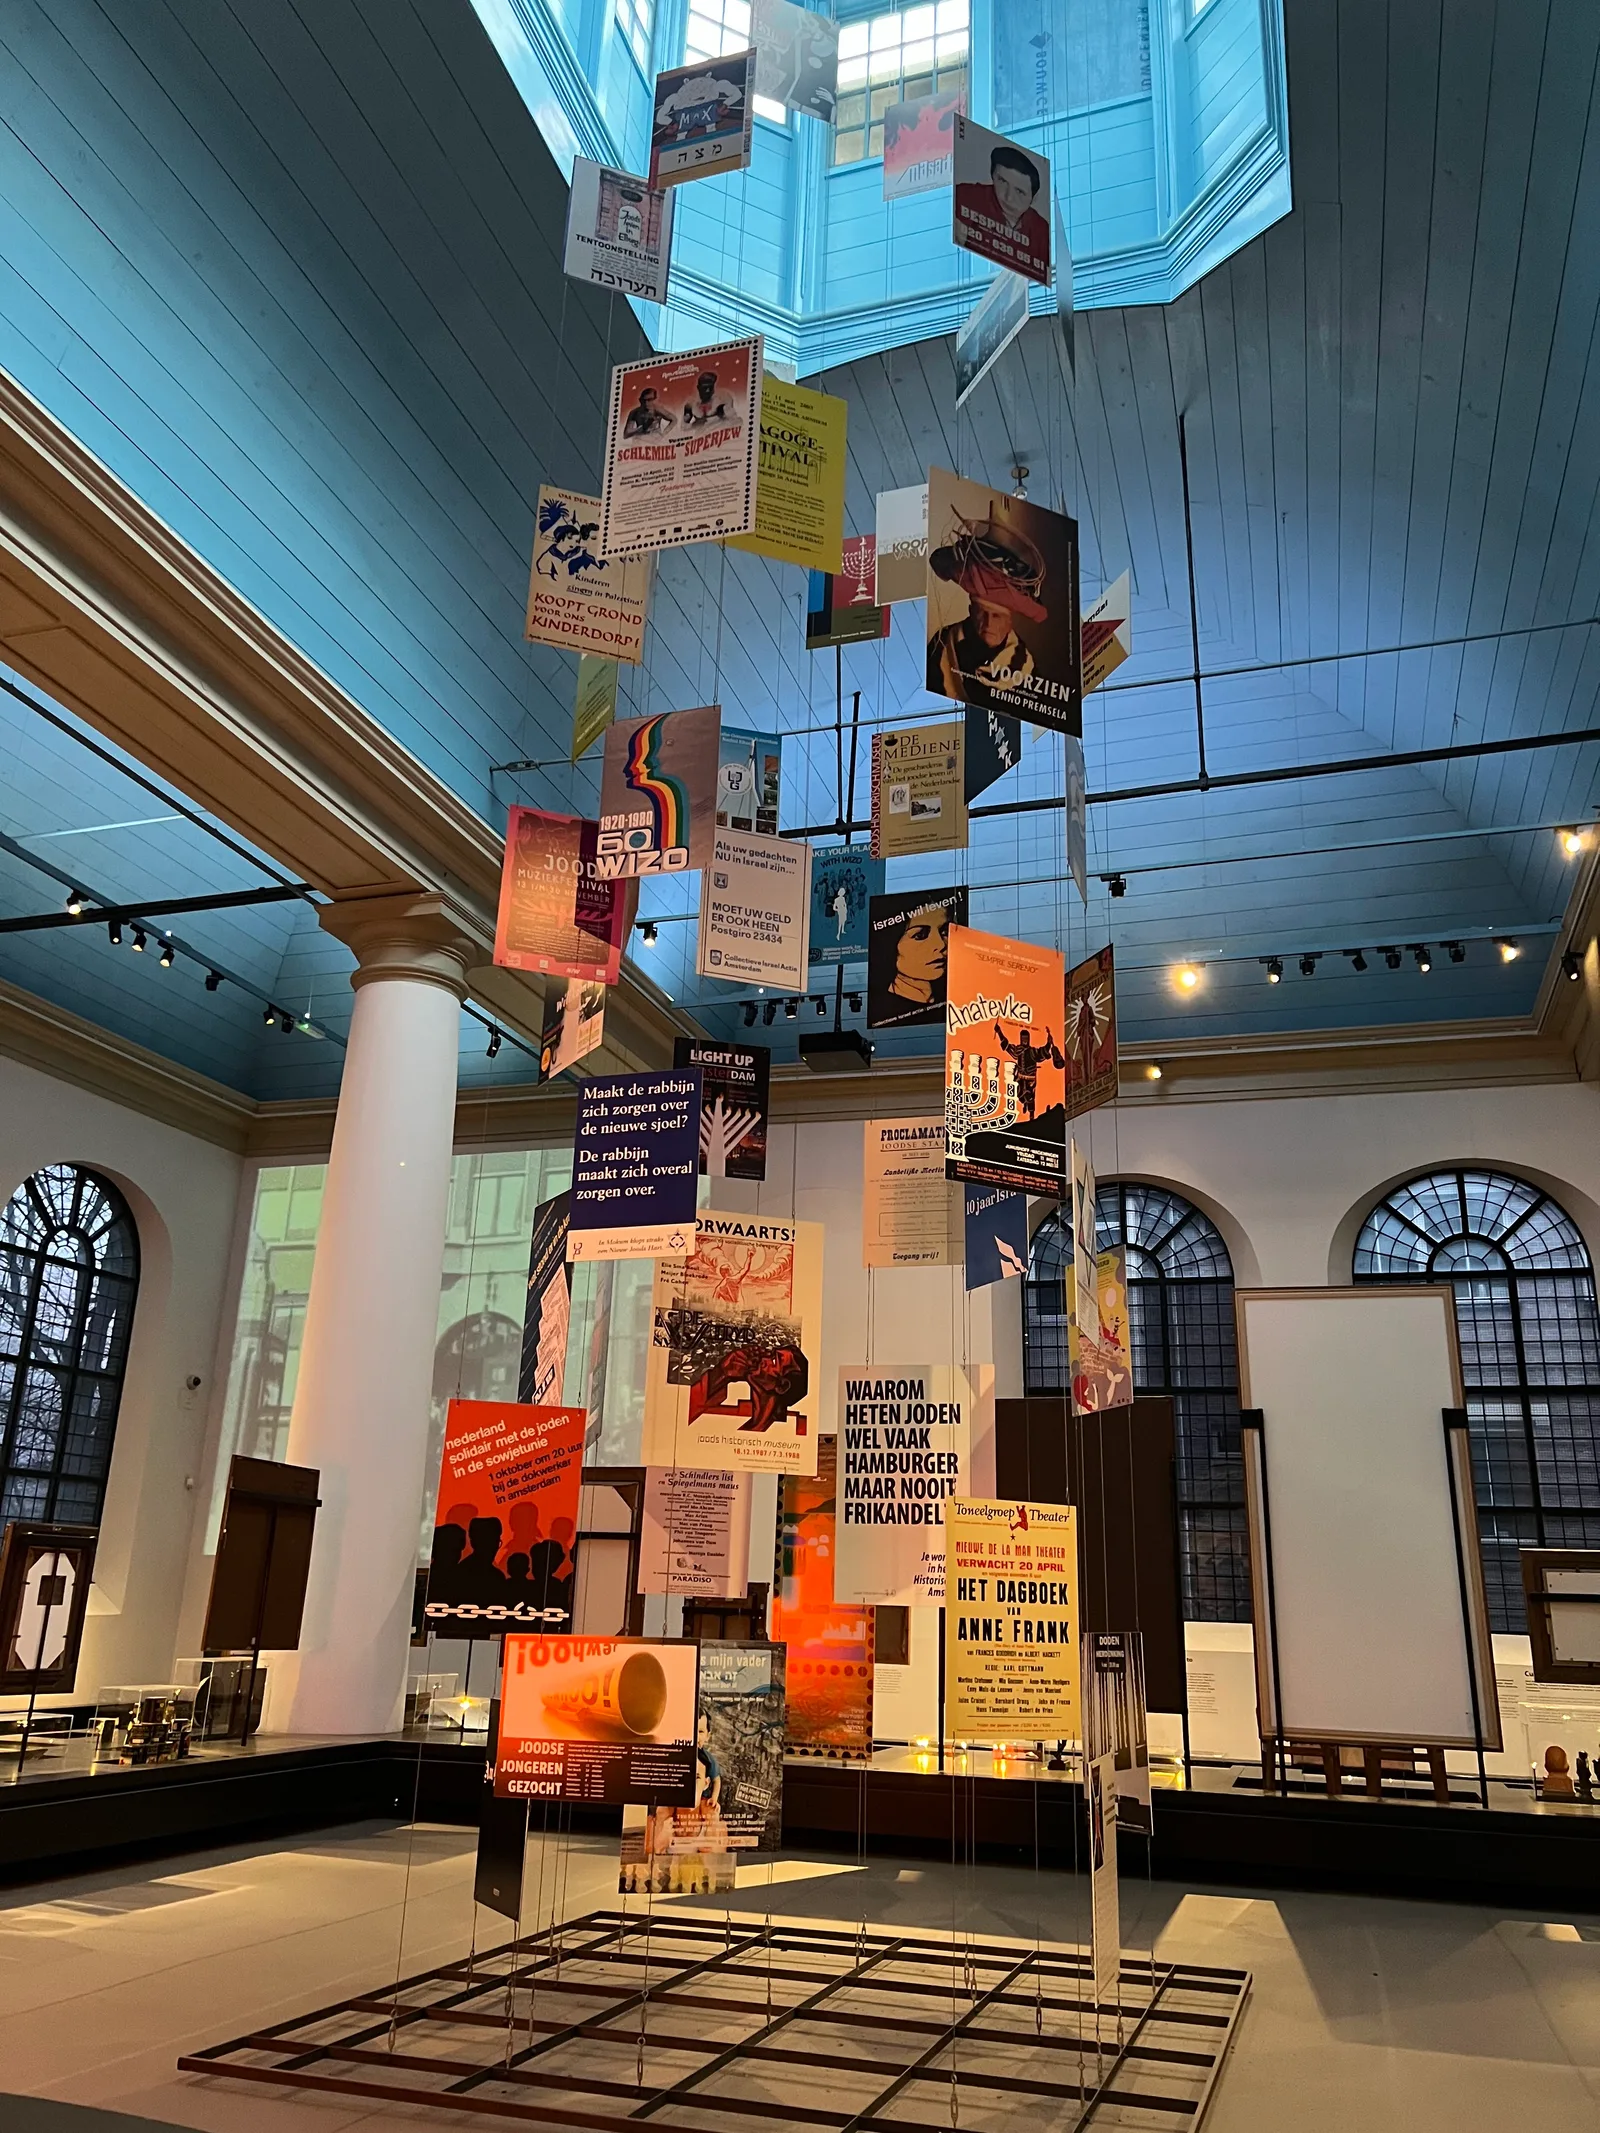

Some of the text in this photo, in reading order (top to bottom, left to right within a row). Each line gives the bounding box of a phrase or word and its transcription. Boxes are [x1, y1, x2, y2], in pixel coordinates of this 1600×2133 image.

[960, 205, 1030, 247] BESPUUGD
[575, 234, 660, 265] TENTOONSTELLING
[617, 425, 742, 462] SCHLEMIEL SUPERJEW
[575, 574, 610, 589] Kinderen
[534, 592, 642, 626] KOOPT GROND
[534, 605, 585, 623] VOOR ONS
[990, 688, 1067, 721] BENNO PREMSELA
[884, 739, 961, 761] MEDIENE
[900, 735, 919, 747] DE
[597, 828, 653, 857] 60
[716, 841, 797, 865] Als uw gedachten
[828, 846, 850, 856] YOUR
[544, 854, 598, 879] JOOD
[596, 846, 690, 879] WIZO
[715, 851, 731, 862] NU
[733, 853, 741, 864] in
[743, 856, 768, 870] Israel
[821, 857, 841, 869] WITH
[518, 868, 611, 894] MUZIEKFESTIVAL
[711, 913, 780, 933] ER OOK HEEN
[712, 902, 791, 925] MOET UW GELD
[873, 895, 957, 932] israel wil leven
[711, 924, 782, 945] Postgiro 23434
[724, 961, 762, 975] Amsterdam
[762, 960, 779, 970] Israel
[948, 994, 1032, 1035] Anatevka
[690, 1049, 754, 1067] LIGHT UP
[583, 1085, 624, 1100] Maakt
[628, 1083, 645, 1096] de
[648, 1080, 695, 1098] rabbijn
[582, 1101, 689, 1118] zich zorgen over
[581, 1114, 689, 1136] de nieuwe sjoel?
[579, 1147, 649, 1165] De rabbijn
[578, 1160, 693, 1182] maakt zich overal
[577, 1184, 656, 1202] zorgen over.
[966, 1193, 996, 1216] 10 jaar
[845, 1379, 924, 1401] WAAROM
[845, 1403, 961, 1425] HETEN JODEN
[445, 1420, 507, 1450] nederland
[448, 1414, 570, 1465] solidair met de joden
[697, 1434, 801, 1450] joods historisch museum
[845, 1427, 931, 1450] WEL VAAK
[453, 1437, 549, 1479] in de sowjetunie
[495, 1459, 534, 1480] oktober
[534, 1455, 551, 1466] om
[551, 1447, 565, 1460] 20
[567, 1442, 584, 1454] uur
[845, 1452, 959, 1475] HAMBURGER
[492, 1458, 572, 1495] bij de dokwerker
[667, 1478, 739, 1490] Spiegelmans maus
[679, 1471, 734, 1482] Schindlers list
[495, 1474, 561, 1505] in amsterdam
[844, 1477, 957, 1500] MAAR NOOIT
[844, 1502, 947, 1526] FRIKANDEL
[954, 1502, 1069, 1523] Toneelgroep Theater
[920, 1552, 930, 1563] Je
[956, 1541, 984, 1554] NIEUWE
[988, 1543, 997, 1555] DE
[1001, 1544, 1010, 1556] LA
[1036, 1546, 1066, 1559] THEATER
[927, 1563, 935, 1573] in
[957, 1558, 1065, 1572] VERWACHT 20 APRIL
[672, 1575, 712, 1584] PARADISO
[957, 1578, 1069, 1605] HET DAGBOEK
[1006, 1607, 1021, 1616] VAN
[957, 1617, 1070, 1644] ANNE FRANK
[1099, 1636, 1119, 1646] DODEN
[709, 1653, 766, 1669] mijn vader
[518, 1740, 565, 1756] JOODSE
[500, 1760, 564, 1776] JONGEREN
[507, 1779, 563, 1796] GEZOCHT
